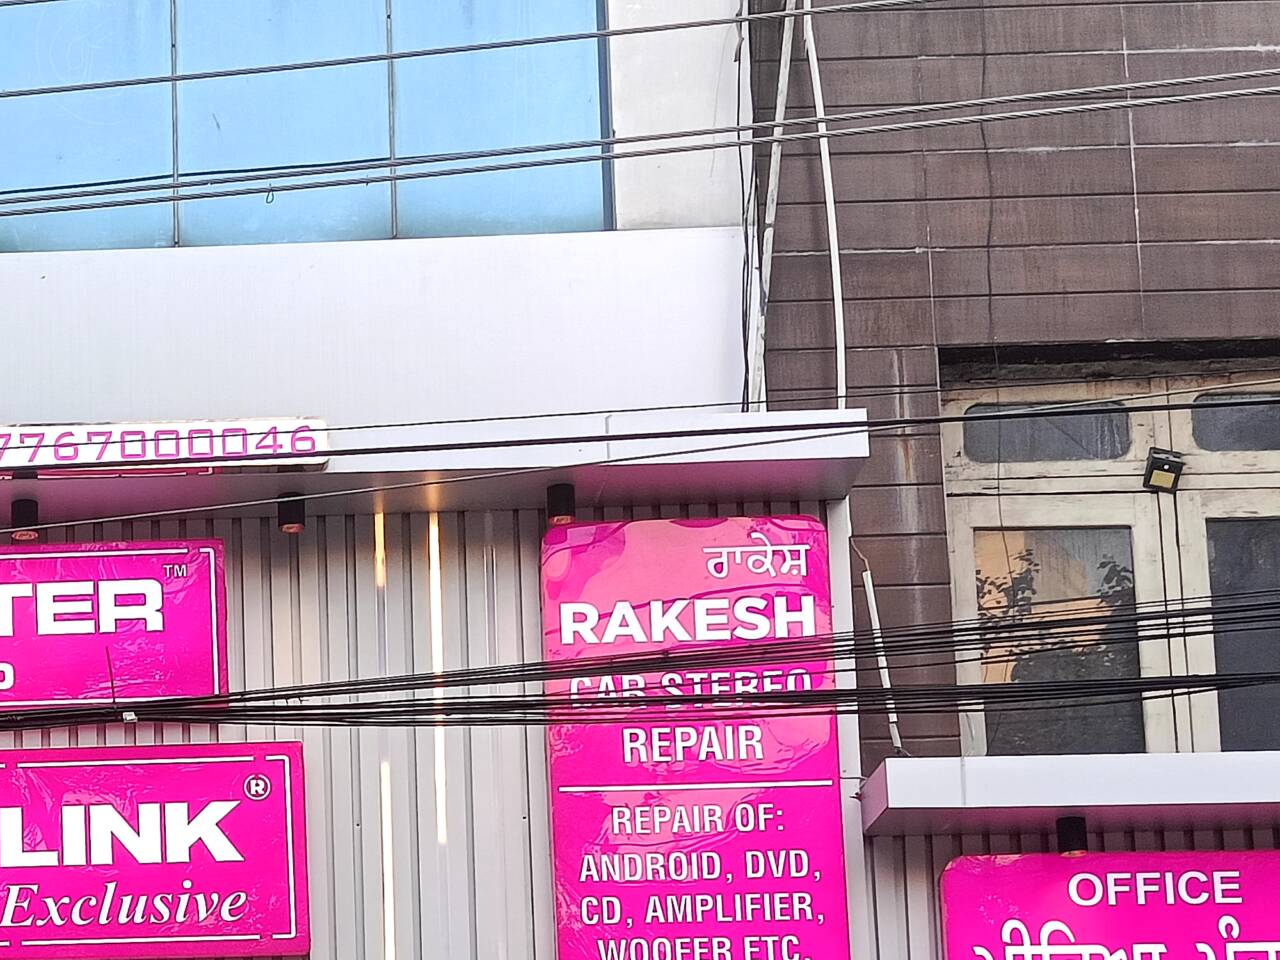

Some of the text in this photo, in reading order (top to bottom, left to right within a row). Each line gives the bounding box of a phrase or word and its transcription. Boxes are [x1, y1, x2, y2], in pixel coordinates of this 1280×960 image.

[703, 531, 811, 578] ਰਾਕੇਸ਼
[560, 594, 816, 644] RAKESH
[623, 725, 764, 763] REPAIR
[612, 803, 785, 835] REPAIR OF:
[579, 849, 821, 883] ANDROID, DVD,
[1067, 870, 1243, 906] OFFICE
[581, 893, 825, 927] CD, AMPLIFIER,
